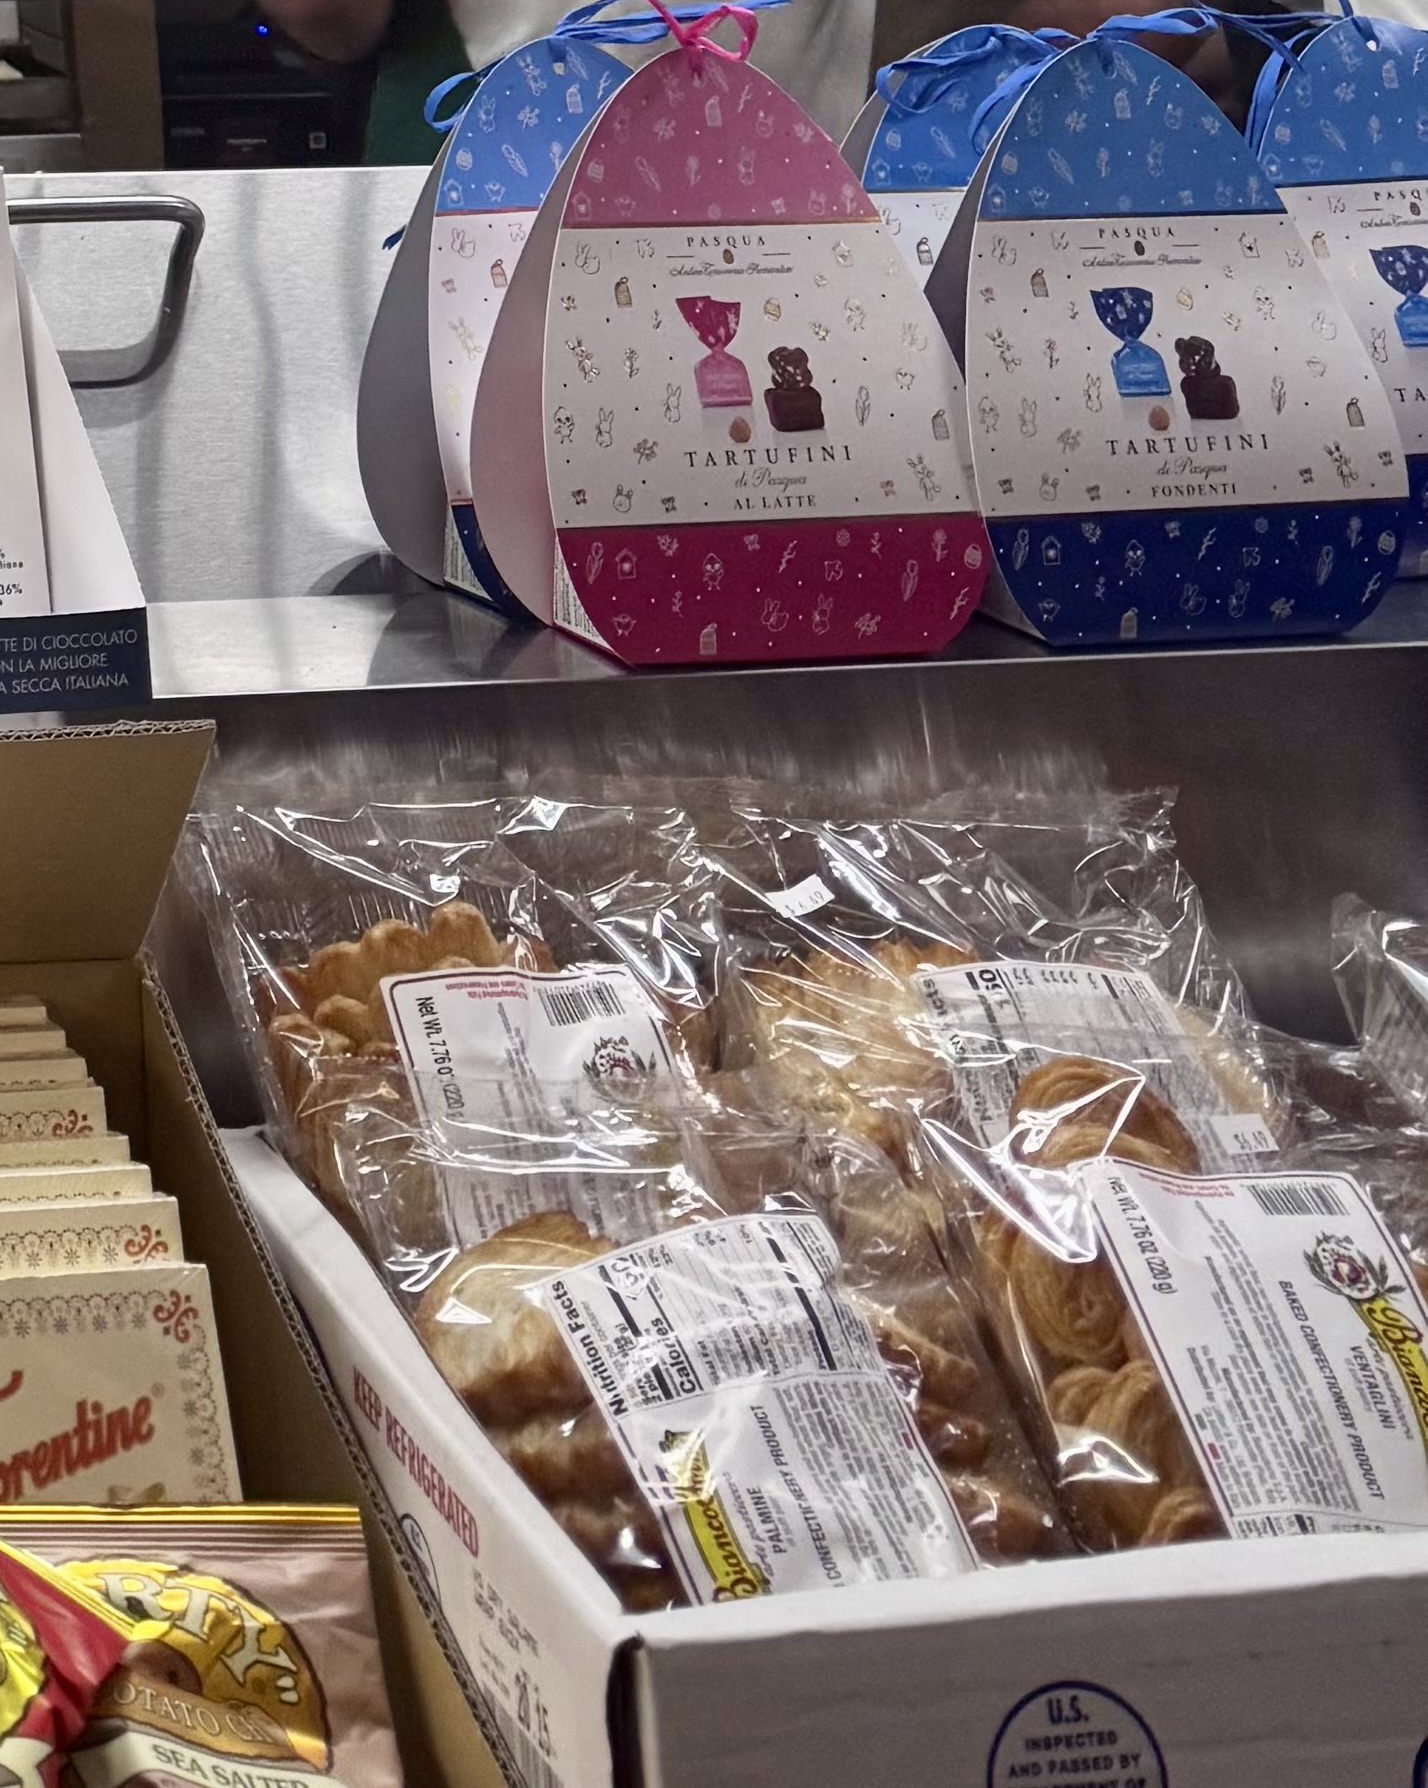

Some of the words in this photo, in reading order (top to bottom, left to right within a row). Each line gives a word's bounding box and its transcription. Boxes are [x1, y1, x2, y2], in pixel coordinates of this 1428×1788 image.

[685, 235, 767, 250] PASQUA
[684, 447, 854, 468] TARTUFINI
[1105, 435, 1271, 456] TARTUFINI
[733, 497, 755, 511] AL
[760, 494, 816, 510] LATTE
[1150, 482, 1237, 499] FONDENTI
[650, 1317, 696, 1395] Calories
[1279, 1280, 1309, 1322] BAKED
[1300, 1325, 1357, 1431] CONFECTIONERY
[1347, 1432, 1385, 1500] PRODUCT
[1350, 1344, 1396, 1429] VENTAGLINI
[352, 1367, 384, 1431] KEEP
[385, 1423, 480, 1558] REFRIGERATED
[746, 1486, 786, 1555] PALMINE
